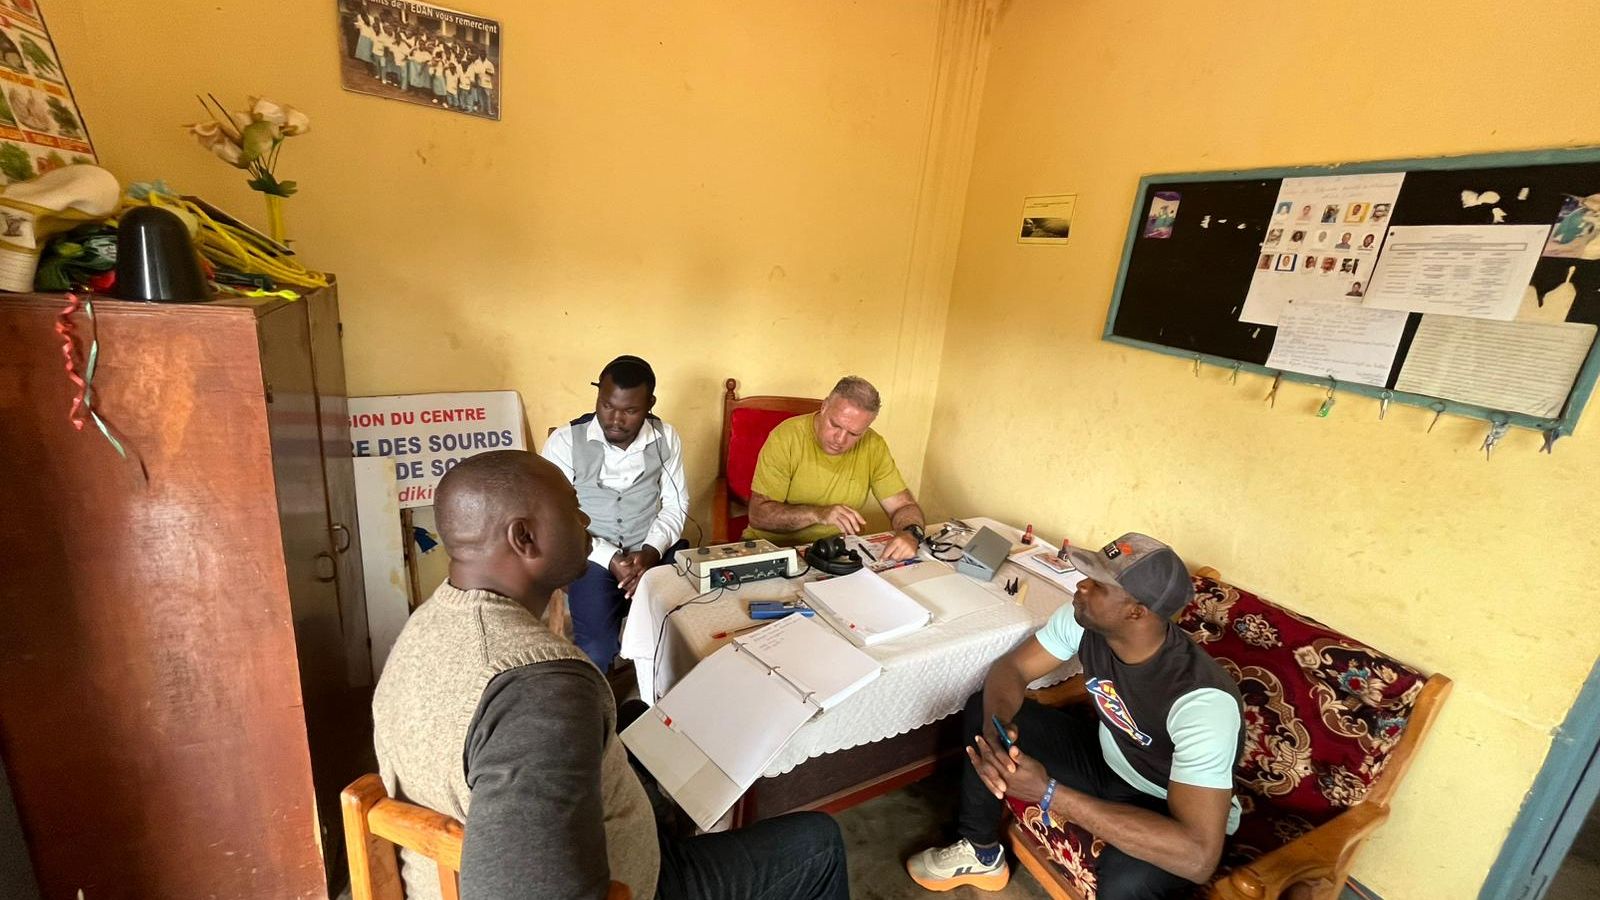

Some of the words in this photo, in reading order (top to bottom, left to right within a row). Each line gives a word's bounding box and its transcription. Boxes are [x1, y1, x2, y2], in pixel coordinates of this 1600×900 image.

[435, 10, 454, 22] vous
[455, 16, 497, 33] remercient
[350, 412, 385, 428] ION
[391, 411, 414, 426] DU
[420, 407, 486, 424] CENTRE
[378, 436, 421, 456] DES
[428, 430, 513, 453] SOURDS
[396, 461, 424, 480] DE
